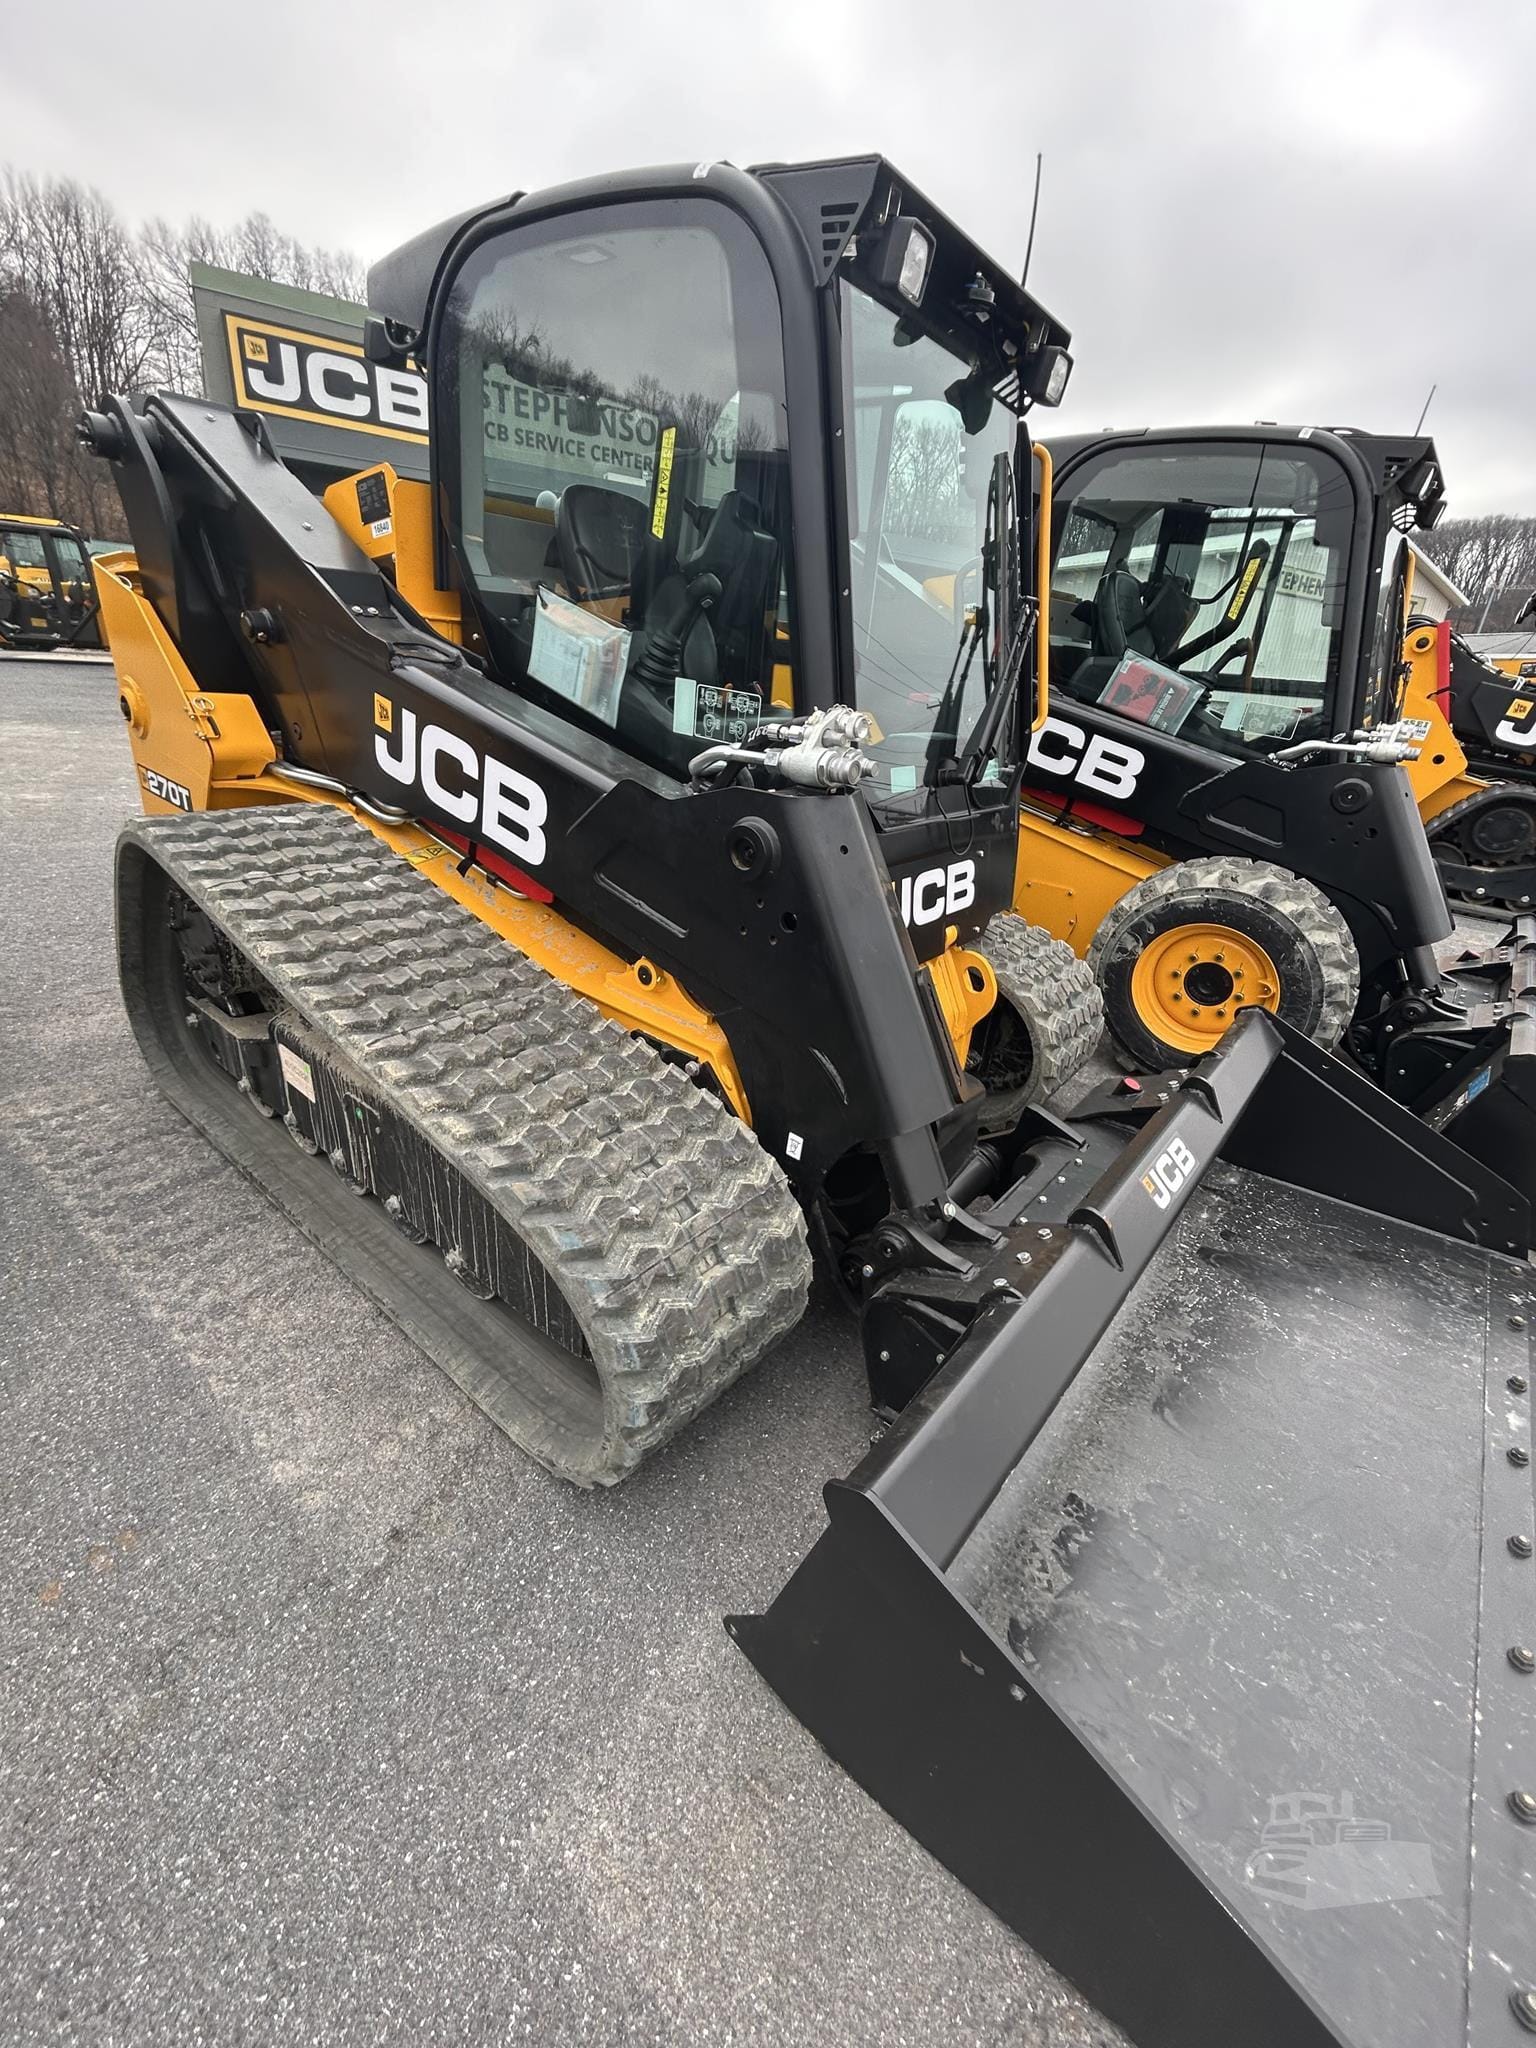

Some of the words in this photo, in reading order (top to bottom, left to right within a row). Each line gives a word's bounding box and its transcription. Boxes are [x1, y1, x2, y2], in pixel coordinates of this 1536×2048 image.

[248, 343, 429, 430] JCB
[482, 379, 657, 446] STEPHNSO
[484, 421, 509, 442] CB
[514, 427, 586, 458] SERVICE
[590, 444, 653, 472] CENTER
[1281, 571, 1323, 597] EPHEN
[147, 770, 190, 812] 270T
[375, 708, 548, 866] JCB
[1027, 716, 1145, 799] CB
[1153, 1137, 1196, 1209] JCB
